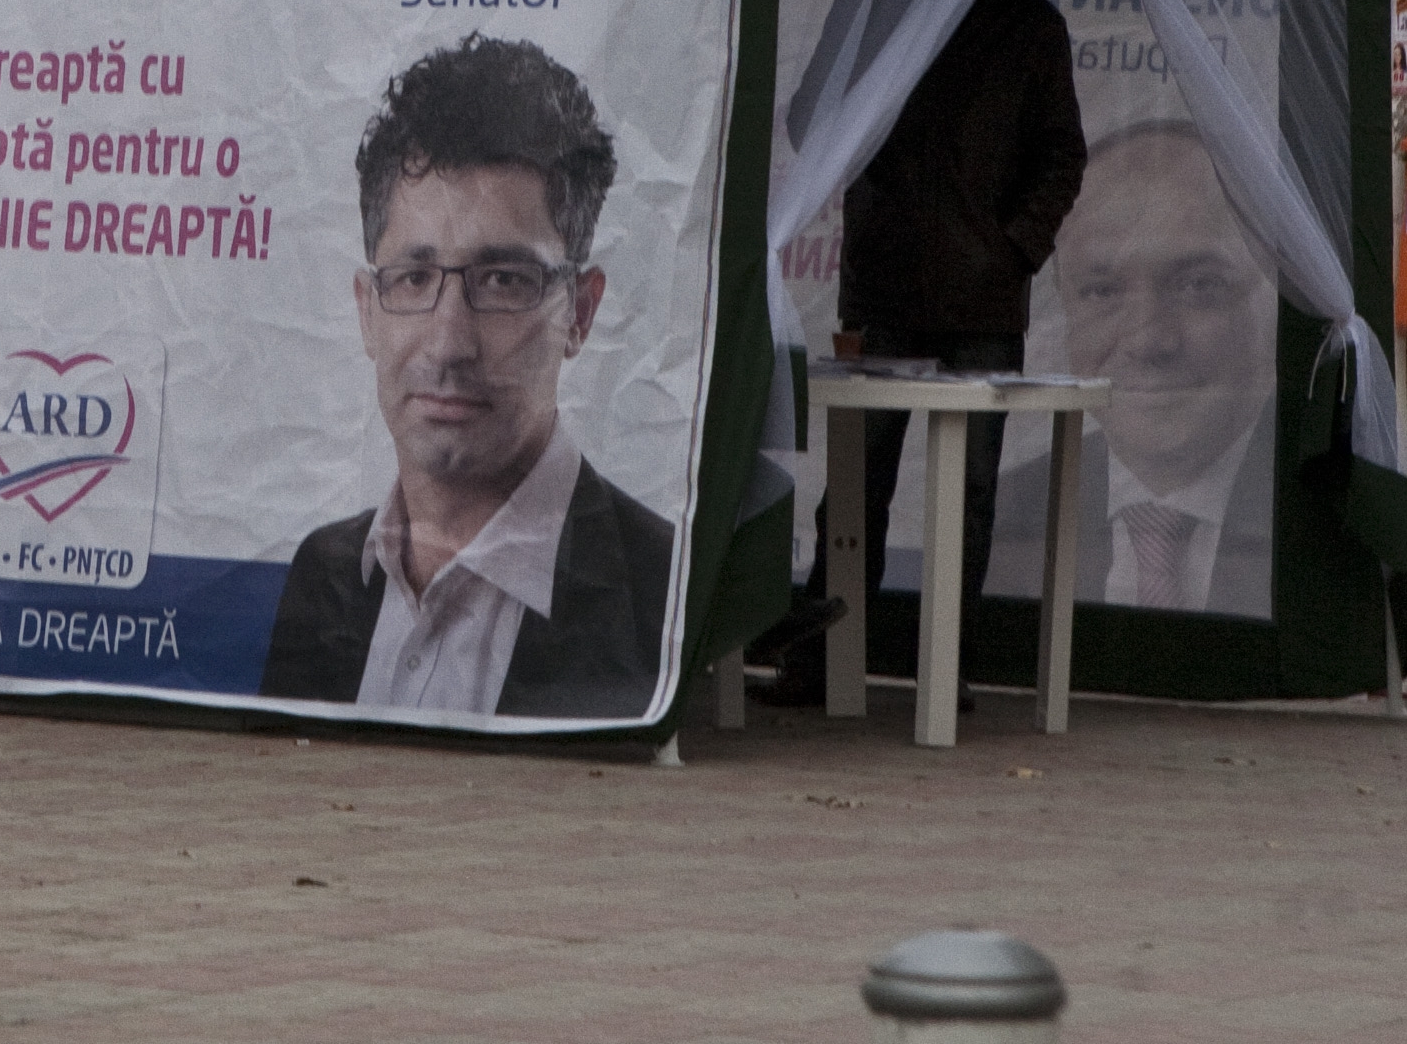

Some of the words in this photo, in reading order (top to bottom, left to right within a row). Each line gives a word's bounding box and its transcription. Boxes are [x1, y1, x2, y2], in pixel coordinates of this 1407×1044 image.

[139, 53, 185, 96] cu
[65, 128, 205, 185] pentru
[215, 136, 241, 178] o
[63, 192, 273, 261] DREAPTĂ!
[19, 542, 44, 571] FC
[17, 607, 181, 660] DREAPTĂ
